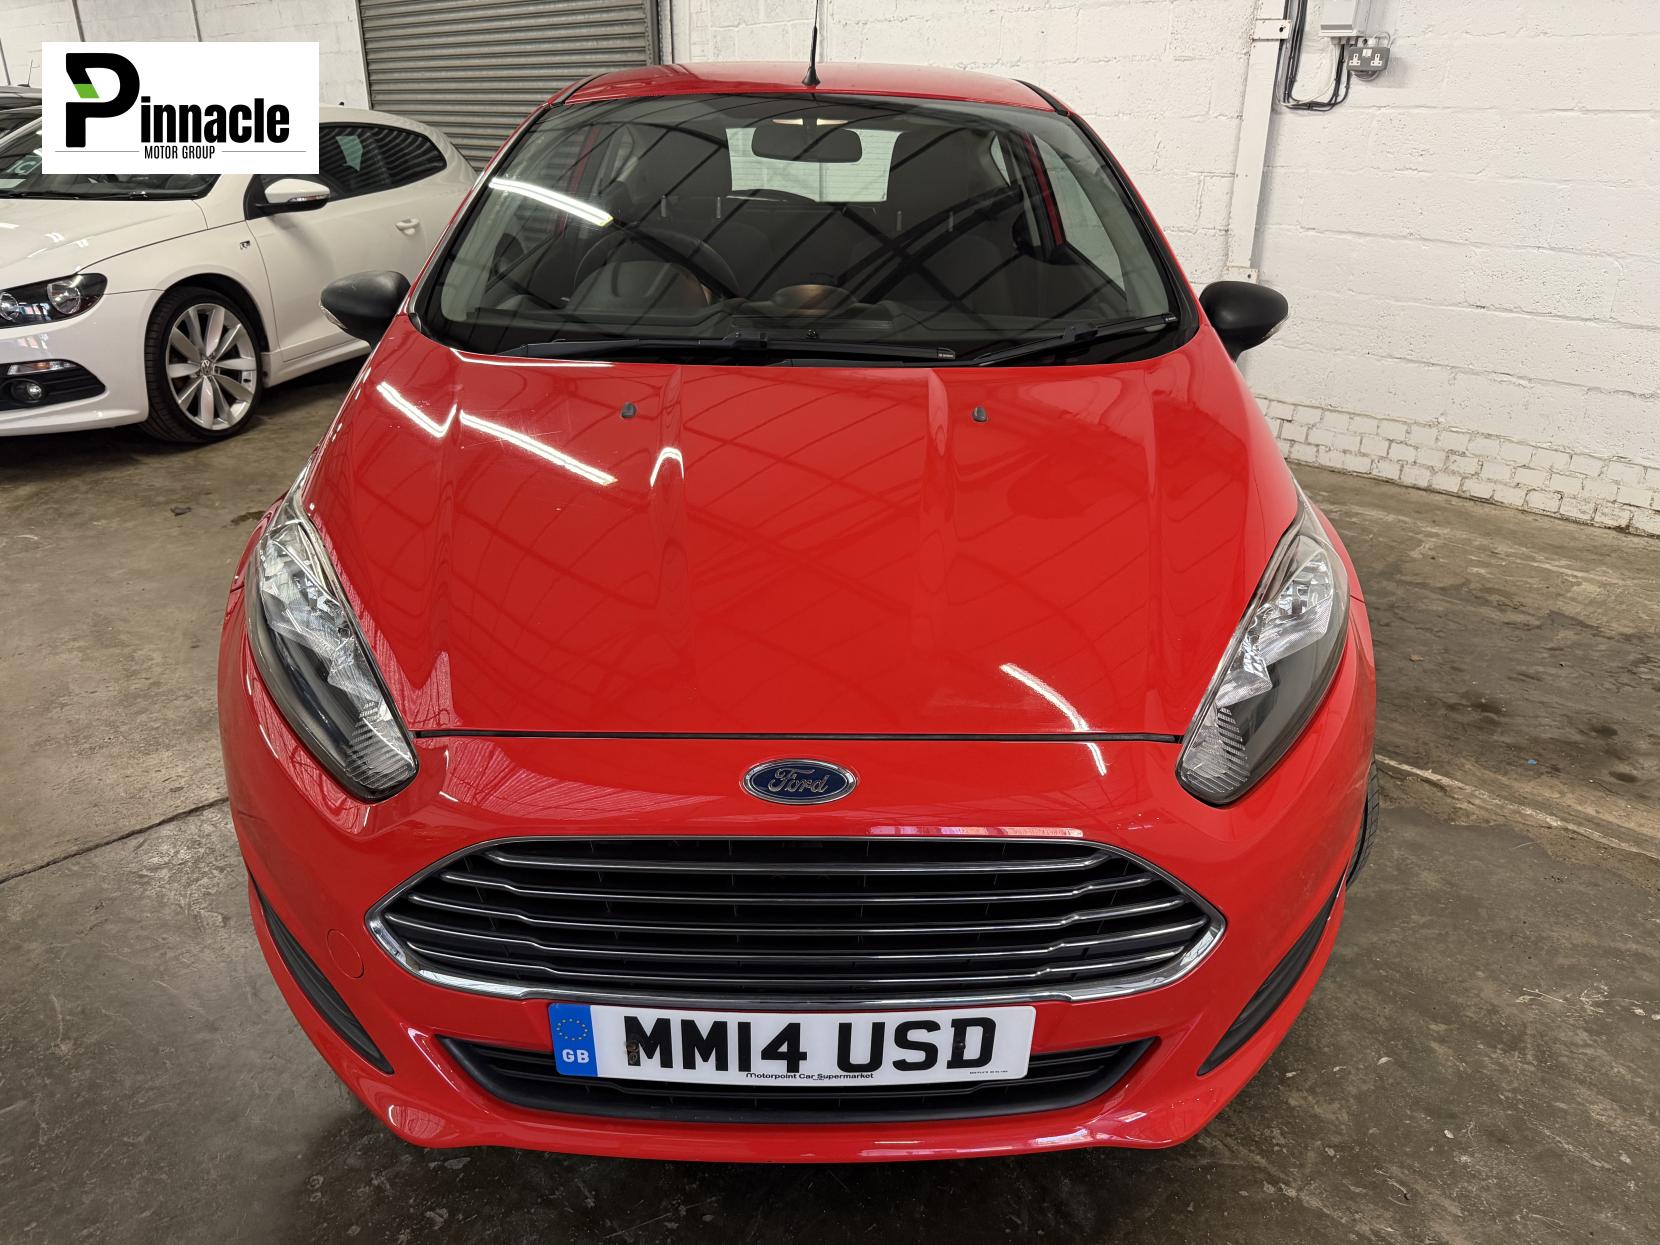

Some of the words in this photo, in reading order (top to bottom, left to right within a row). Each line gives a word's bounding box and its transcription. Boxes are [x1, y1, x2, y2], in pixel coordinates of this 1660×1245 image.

[767, 768, 830, 793] Ford
[624, 1015, 807, 1073] MM14
[837, 1016, 997, 1073] USD
[562, 1048, 590, 1064] GB
[745, 1072, 797, 1080] Motorpoint
[816, 1072, 874, 1080] Supermarket
